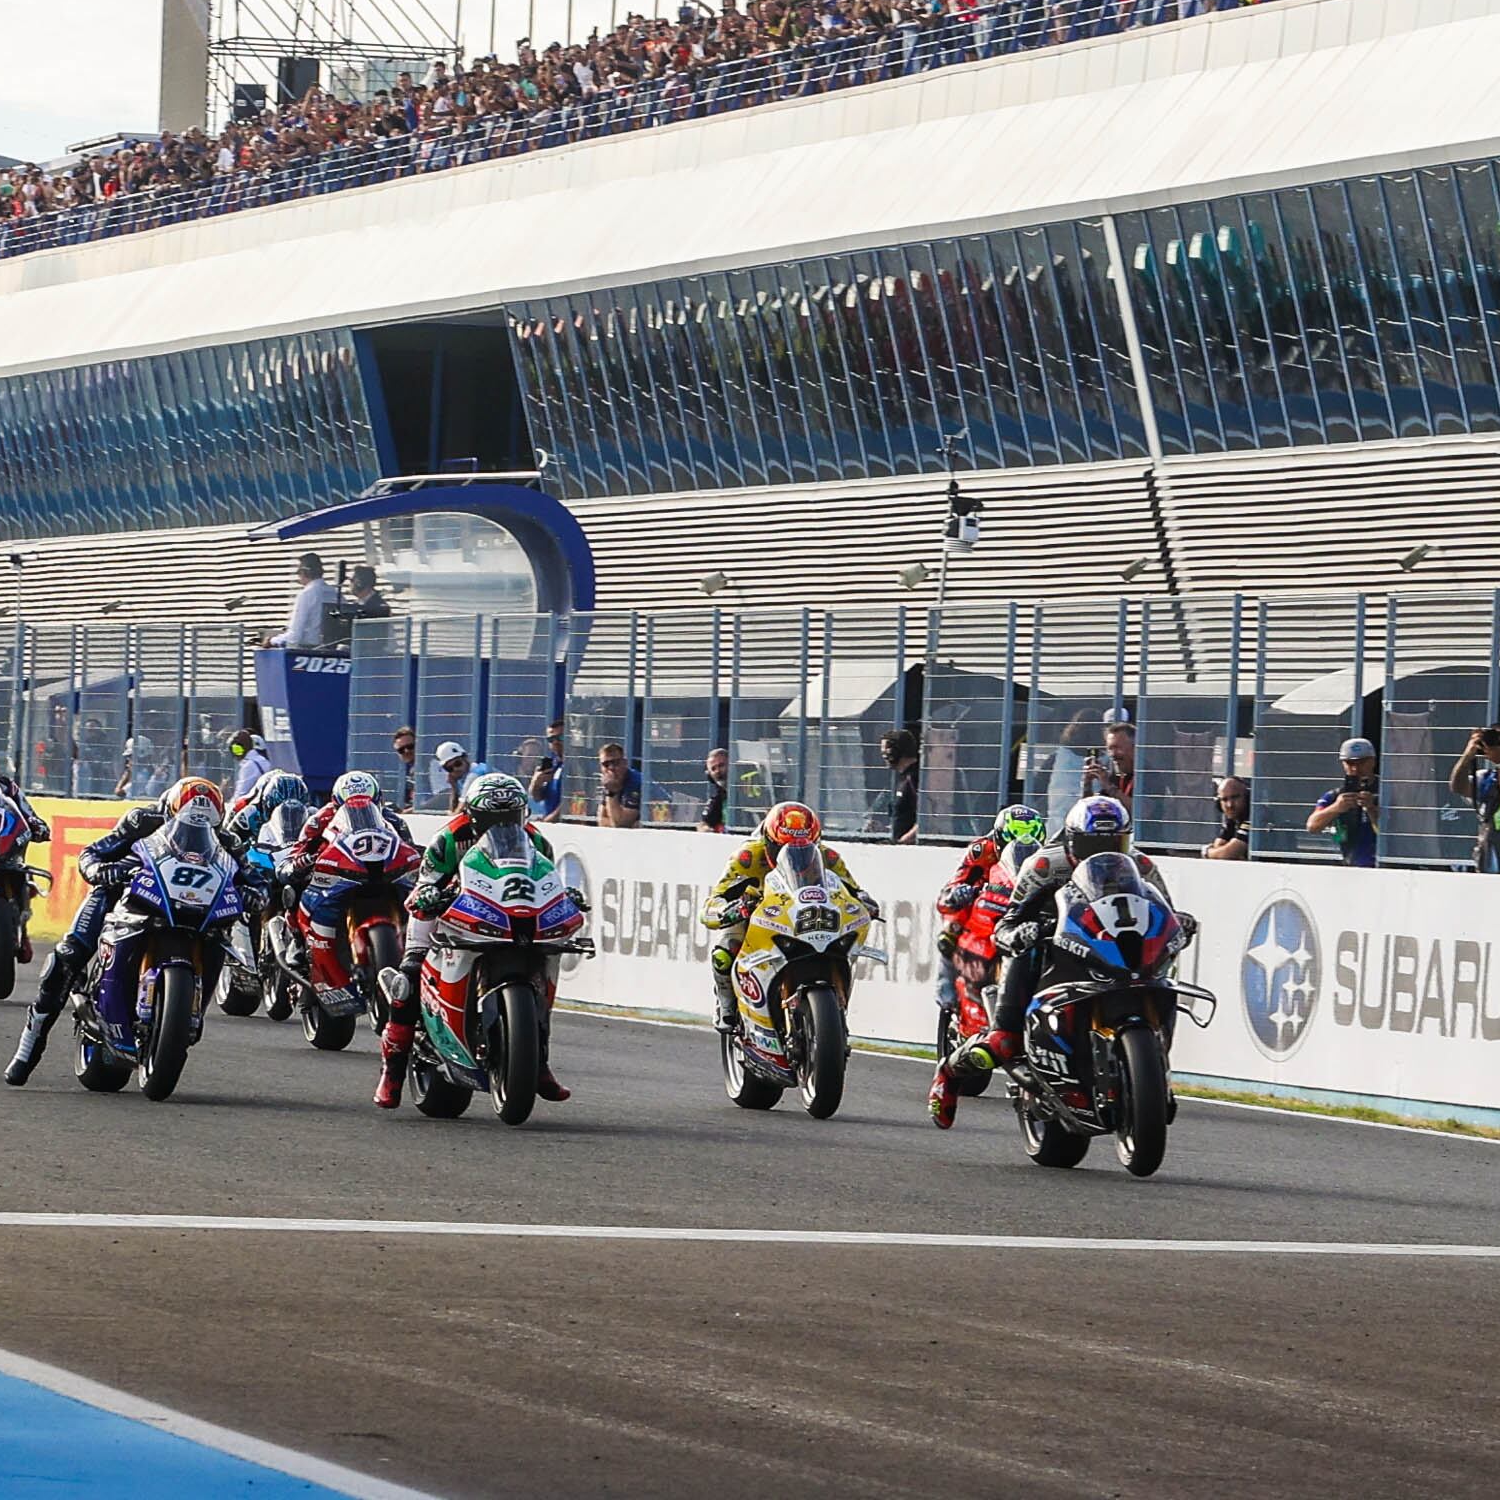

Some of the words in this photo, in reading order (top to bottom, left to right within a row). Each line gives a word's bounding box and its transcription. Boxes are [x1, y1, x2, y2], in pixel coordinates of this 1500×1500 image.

[292, 656, 352, 674] 2025
[352, 834, 391, 857] 97
[137, 875, 156, 889] KB
[171, 866, 214, 889] 87
[136, 887, 162, 906] YAMAHA
[501, 876, 537, 903] 22
[215, 906, 238, 918] YAMAHA
[601, 878, 711, 962] SUBARU
[1111, 896, 1139, 928] 1
